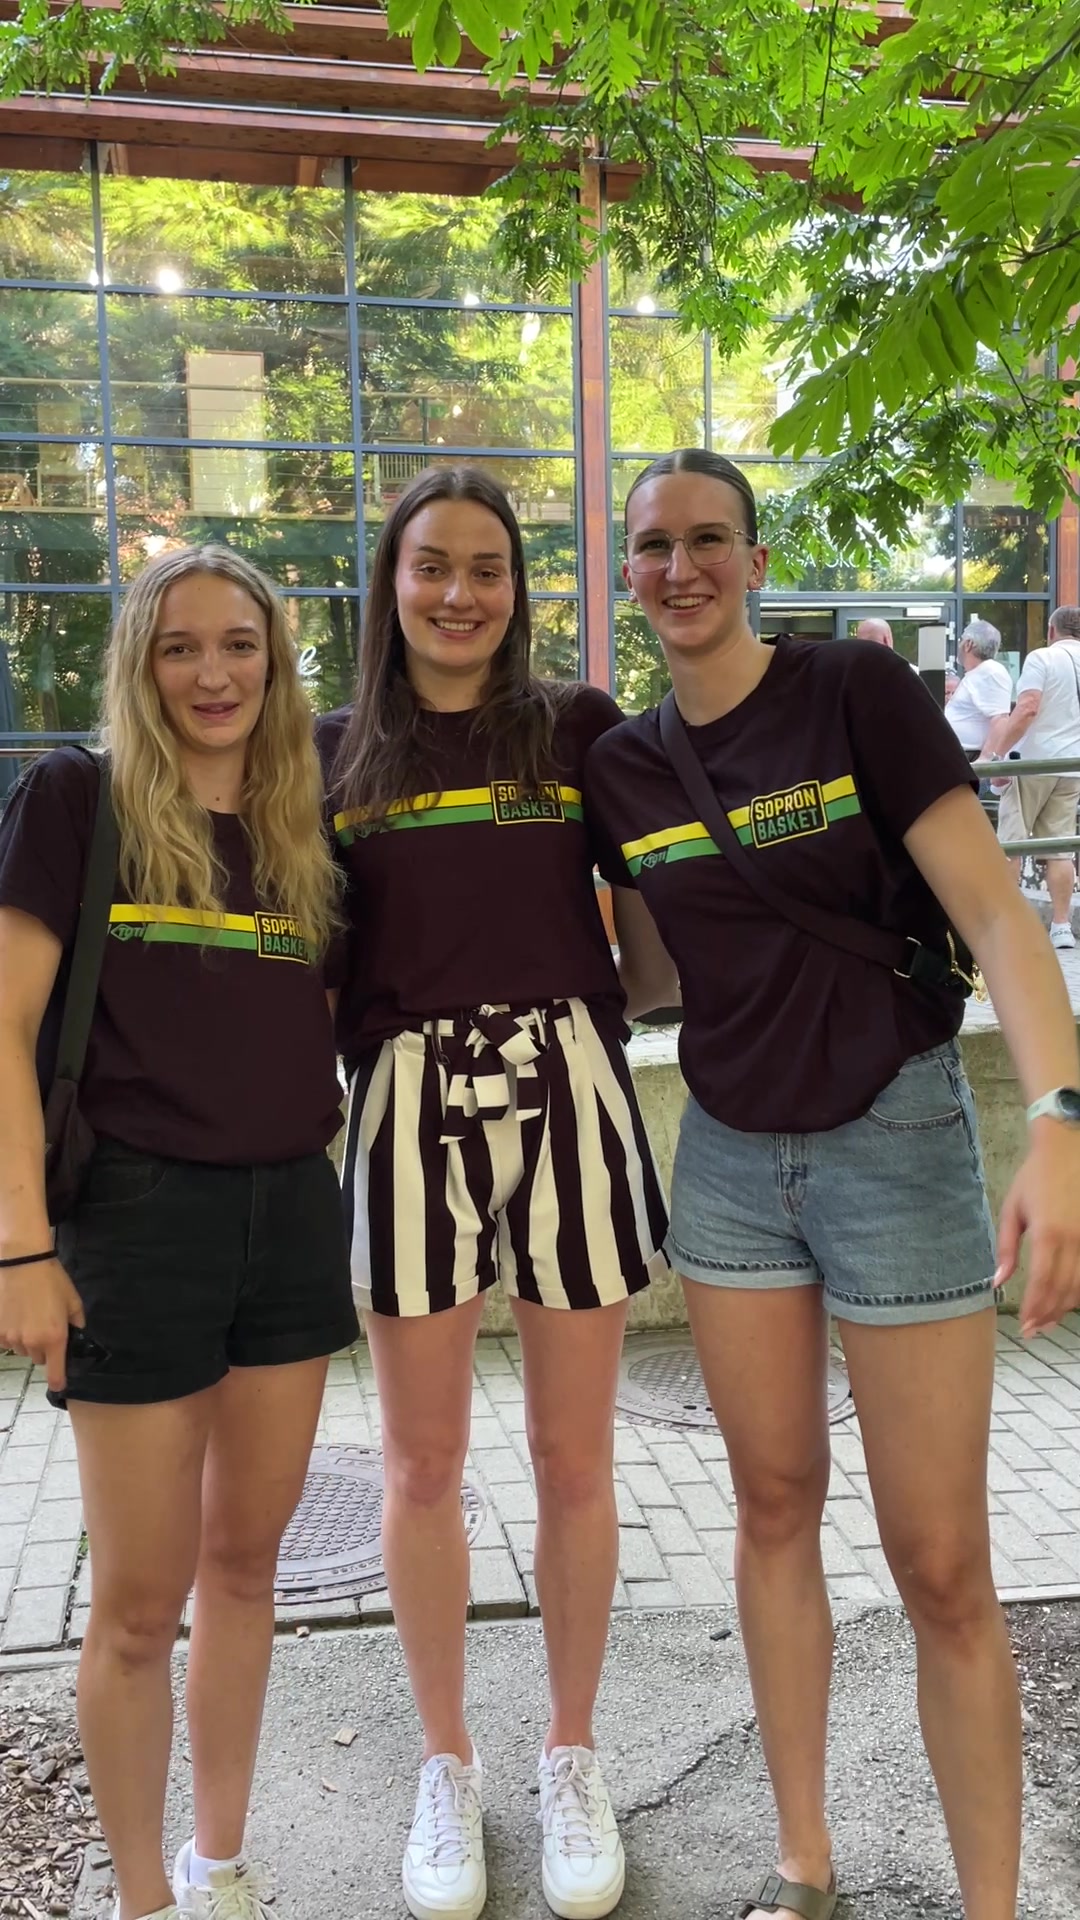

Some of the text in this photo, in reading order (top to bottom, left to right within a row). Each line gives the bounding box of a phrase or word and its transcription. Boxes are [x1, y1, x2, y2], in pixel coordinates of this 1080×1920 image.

[498, 785, 556, 801] SOON
[755, 787, 816, 820] SOPRON
[500, 801, 557, 819] BASKET
[757, 807, 818, 840] BASKET
[261, 917, 305, 937] SOPRO
[263, 934, 305, 956] BASKE
